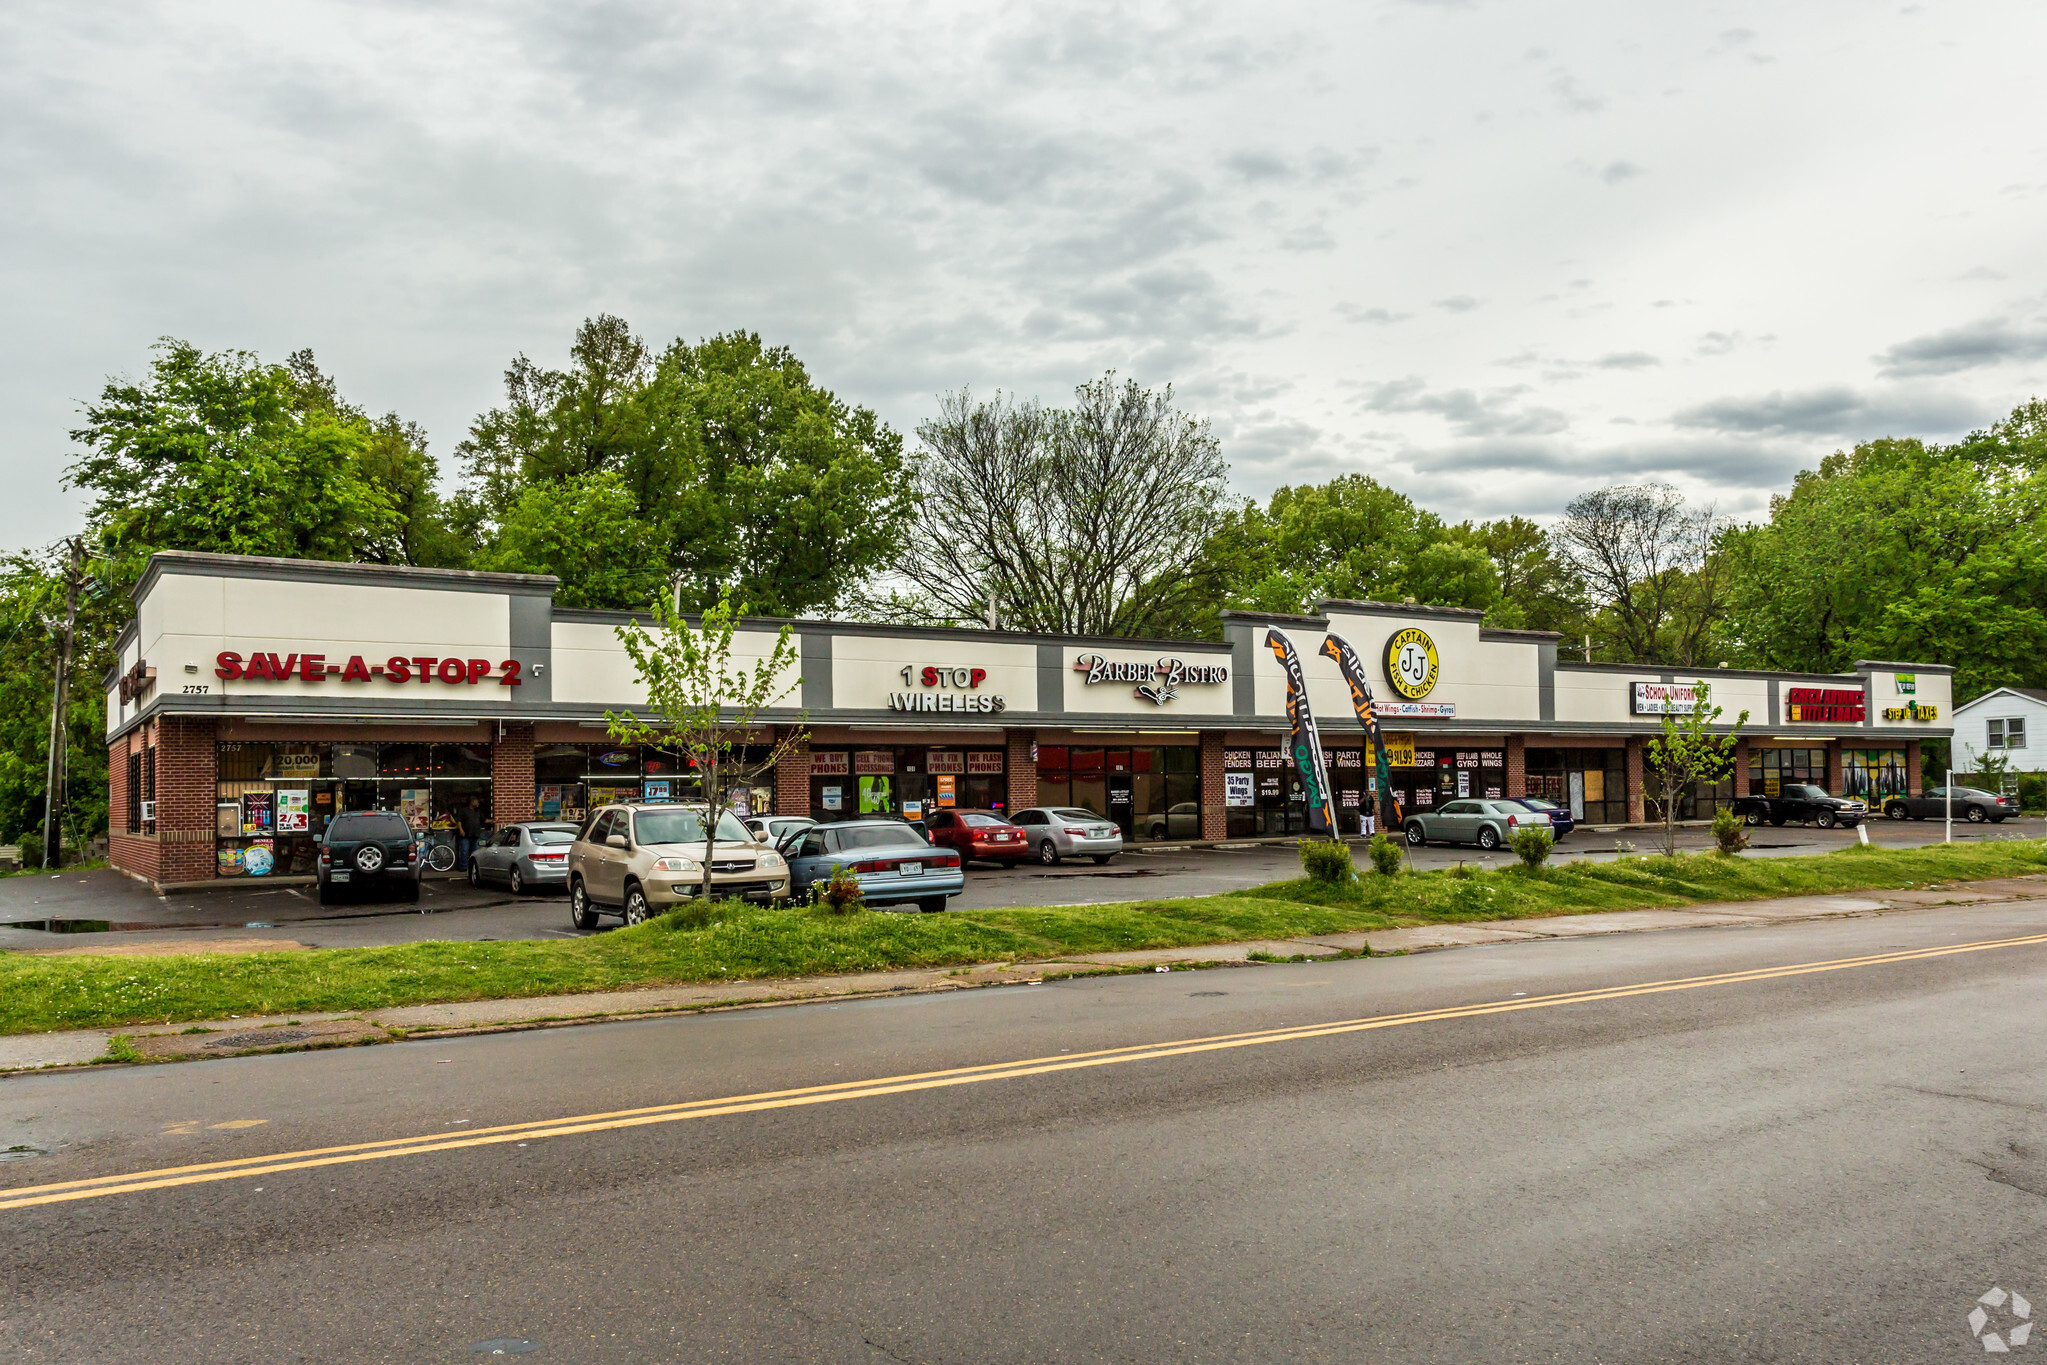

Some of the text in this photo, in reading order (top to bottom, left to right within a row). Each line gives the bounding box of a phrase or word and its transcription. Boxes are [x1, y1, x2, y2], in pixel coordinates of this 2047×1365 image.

[1394, 631, 1432, 652] CAPTAIN
[214, 651, 522, 686] SAVE-A-STOP 2
[900, 665, 987, 689] 1 STOP
[1390, 662, 1438, 697] FISH & CHICKEN
[182, 685, 209, 694] 2757
[1645, 684, 1669, 700] SCHOOL
[1791, 687, 1866, 705] CHECK ADVANCE
[888, 692, 1007, 713] WIRELESS
[1384, 704, 1400, 714] Wings
[1401, 705, 1419, 713] Catfish
[1420, 705, 1438, 716] Shrimp
[1439, 705, 1454, 715] Gyros
[1647, 703, 1659, 712] LADIES
[1801, 705, 1829, 721] TITLE
[1829, 706, 1866, 722] LOANS
[1888, 706, 1938, 720] STEP UP TAXES
[220, 744, 241, 752] 2757
[814, 754, 844, 763] WE BUY
[856, 754, 894, 763] CELL PHONE
[932, 754, 944, 762] WE
[969, 754, 1002, 762] WE FLASH
[1224, 751, 1251, 760] CHICKEN
[811, 763, 848, 773] PHONES
[855, 763, 894, 772] ACCESSORIES
[929, 763, 963, 772] PHONES
[968, 763, 1002, 772] PHONES
[1224, 760, 1252, 768] TENDERS
[1256, 760, 1282, 768] BEEF
[1337, 760, 1361, 768] WINGS
[1456, 760, 1479, 768] GYRO
[1227, 776, 1234, 785] 35
[1235, 776, 1249, 786] Party
[1229, 786, 1248, 796] Wings
